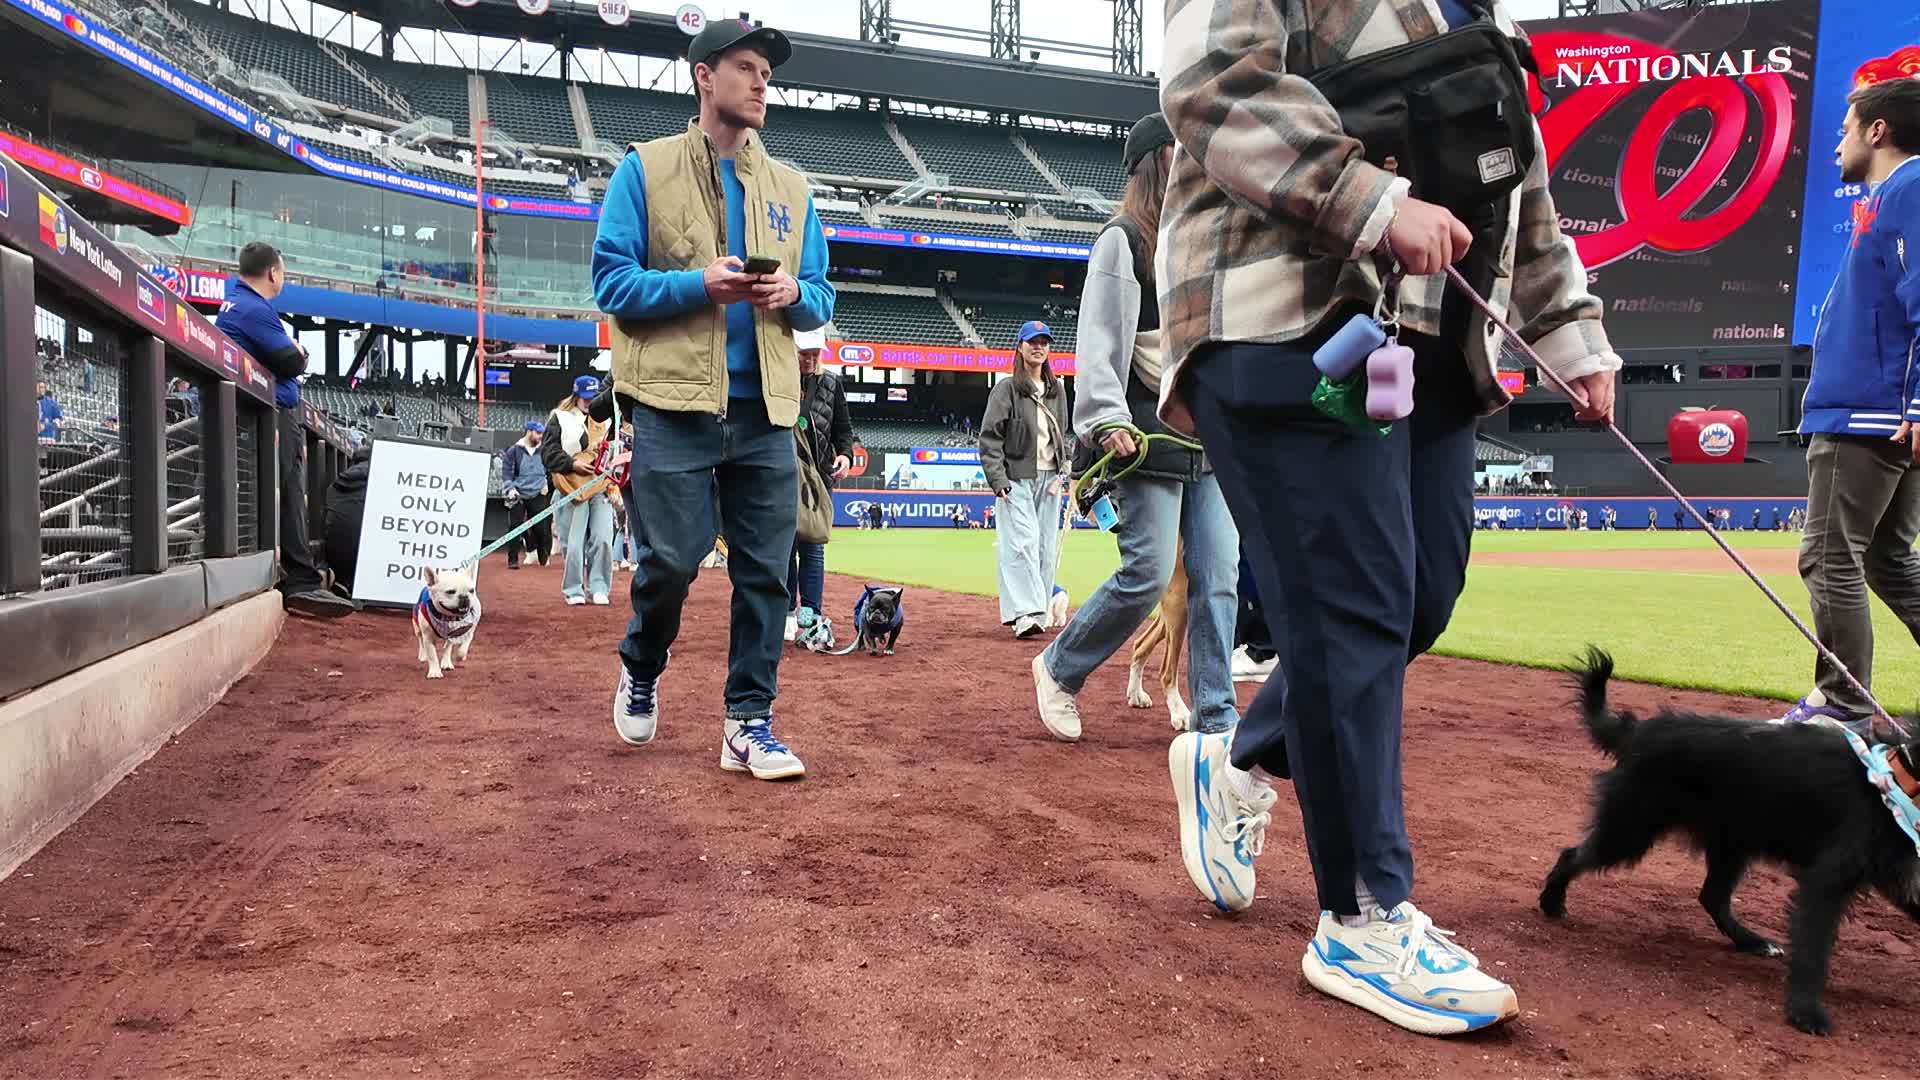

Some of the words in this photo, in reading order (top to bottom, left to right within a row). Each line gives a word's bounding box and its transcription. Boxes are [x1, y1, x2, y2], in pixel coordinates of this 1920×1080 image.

[601, 2, 626, 16] SHEA
[681, 12, 700, 27] 42
[1555, 43, 1631, 60] Washington
[1555, 45, 1793, 88] NATIONALS
[401, 178, 425, 190] COULD
[426, 183, 440, 194] WIN
[440, 186, 456, 197] YOU
[766, 200, 792, 242] NY
[69, 225, 86, 256] New
[86, 239, 101, 269] York
[101, 250, 122, 288] Lottery
[190, 275, 225, 299] LGM
[1611, 296, 1704, 313] nationals
[1712, 323, 1785, 339] nationals
[880, 349, 921, 365] ENTER
[926, 351, 947, 365] ON
[950, 352, 974, 366] THE
[977, 354, 1008, 367] NEW
[397, 471, 465, 492] MEDIA
[401, 495, 456, 513] ONLY
[381, 515, 470, 538] BEYOND
[398, 541, 448, 559] THIS
